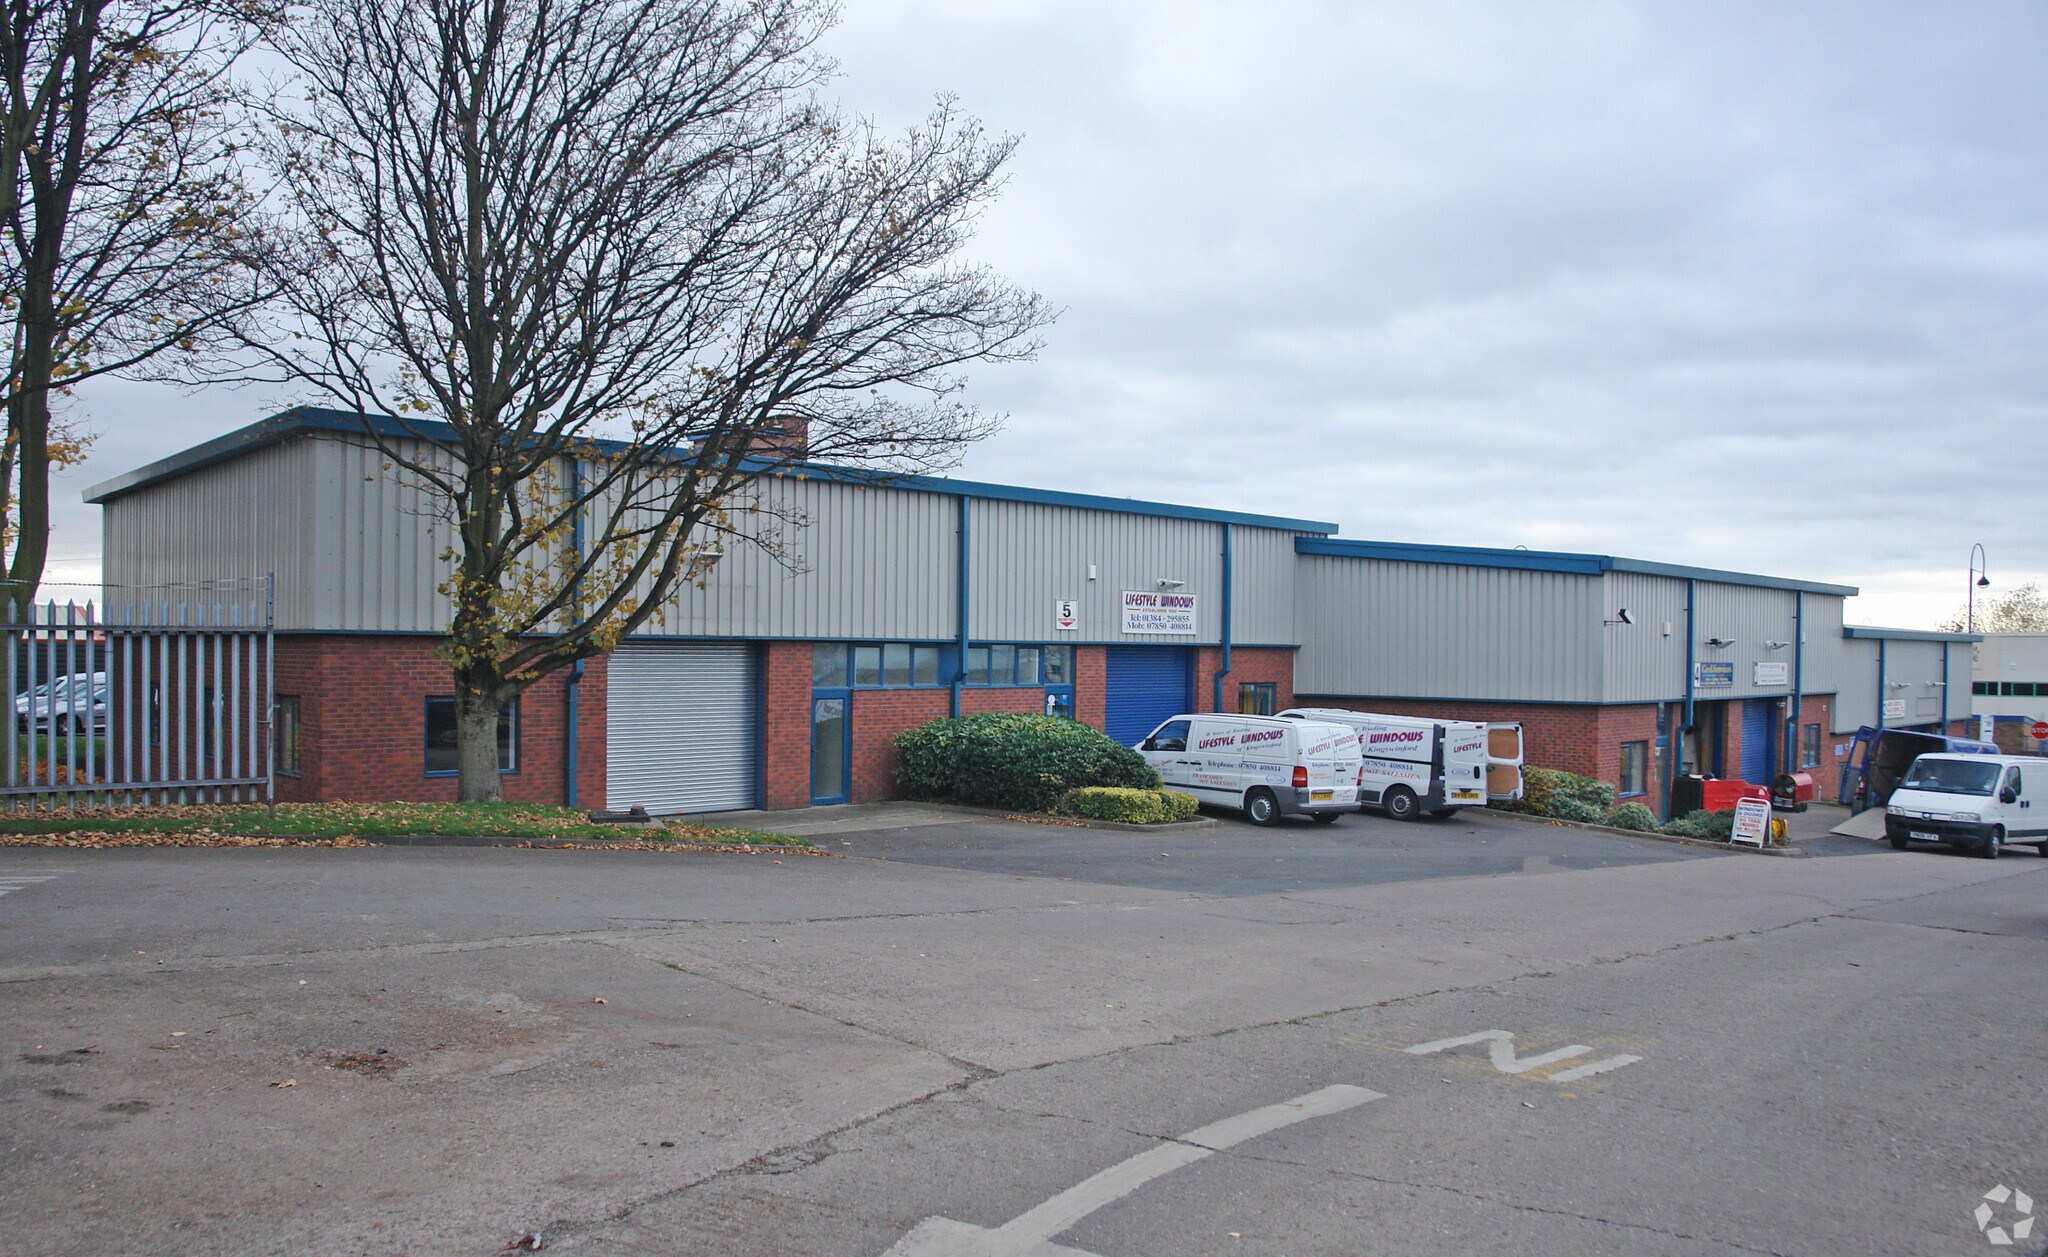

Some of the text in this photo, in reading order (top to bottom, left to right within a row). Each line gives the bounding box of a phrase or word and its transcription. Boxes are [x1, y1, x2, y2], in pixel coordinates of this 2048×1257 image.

[1125, 593, 1194, 609] LIFESTYLE WINDOWS
[1063, 604, 1071, 618] 5
[1142, 614, 1161, 622] 01384
[1166, 615, 1190, 623] 295855
[1126, 621, 1192, 631] Mob: 07850 408814
[1199, 729, 1284, 750] LIFESTYLE WINDOWS
[1369, 731, 1424, 744] WINDOWS
[1308, 742, 1331, 755] LIFESTYLE
[1368, 745, 1418, 753] Kingswinford
[1453, 742, 1482, 753] LIFESTYLE
[1207, 760, 1281, 772] Telephone: 07850 408814
[1365, 760, 1413, 771] 07850 408814
